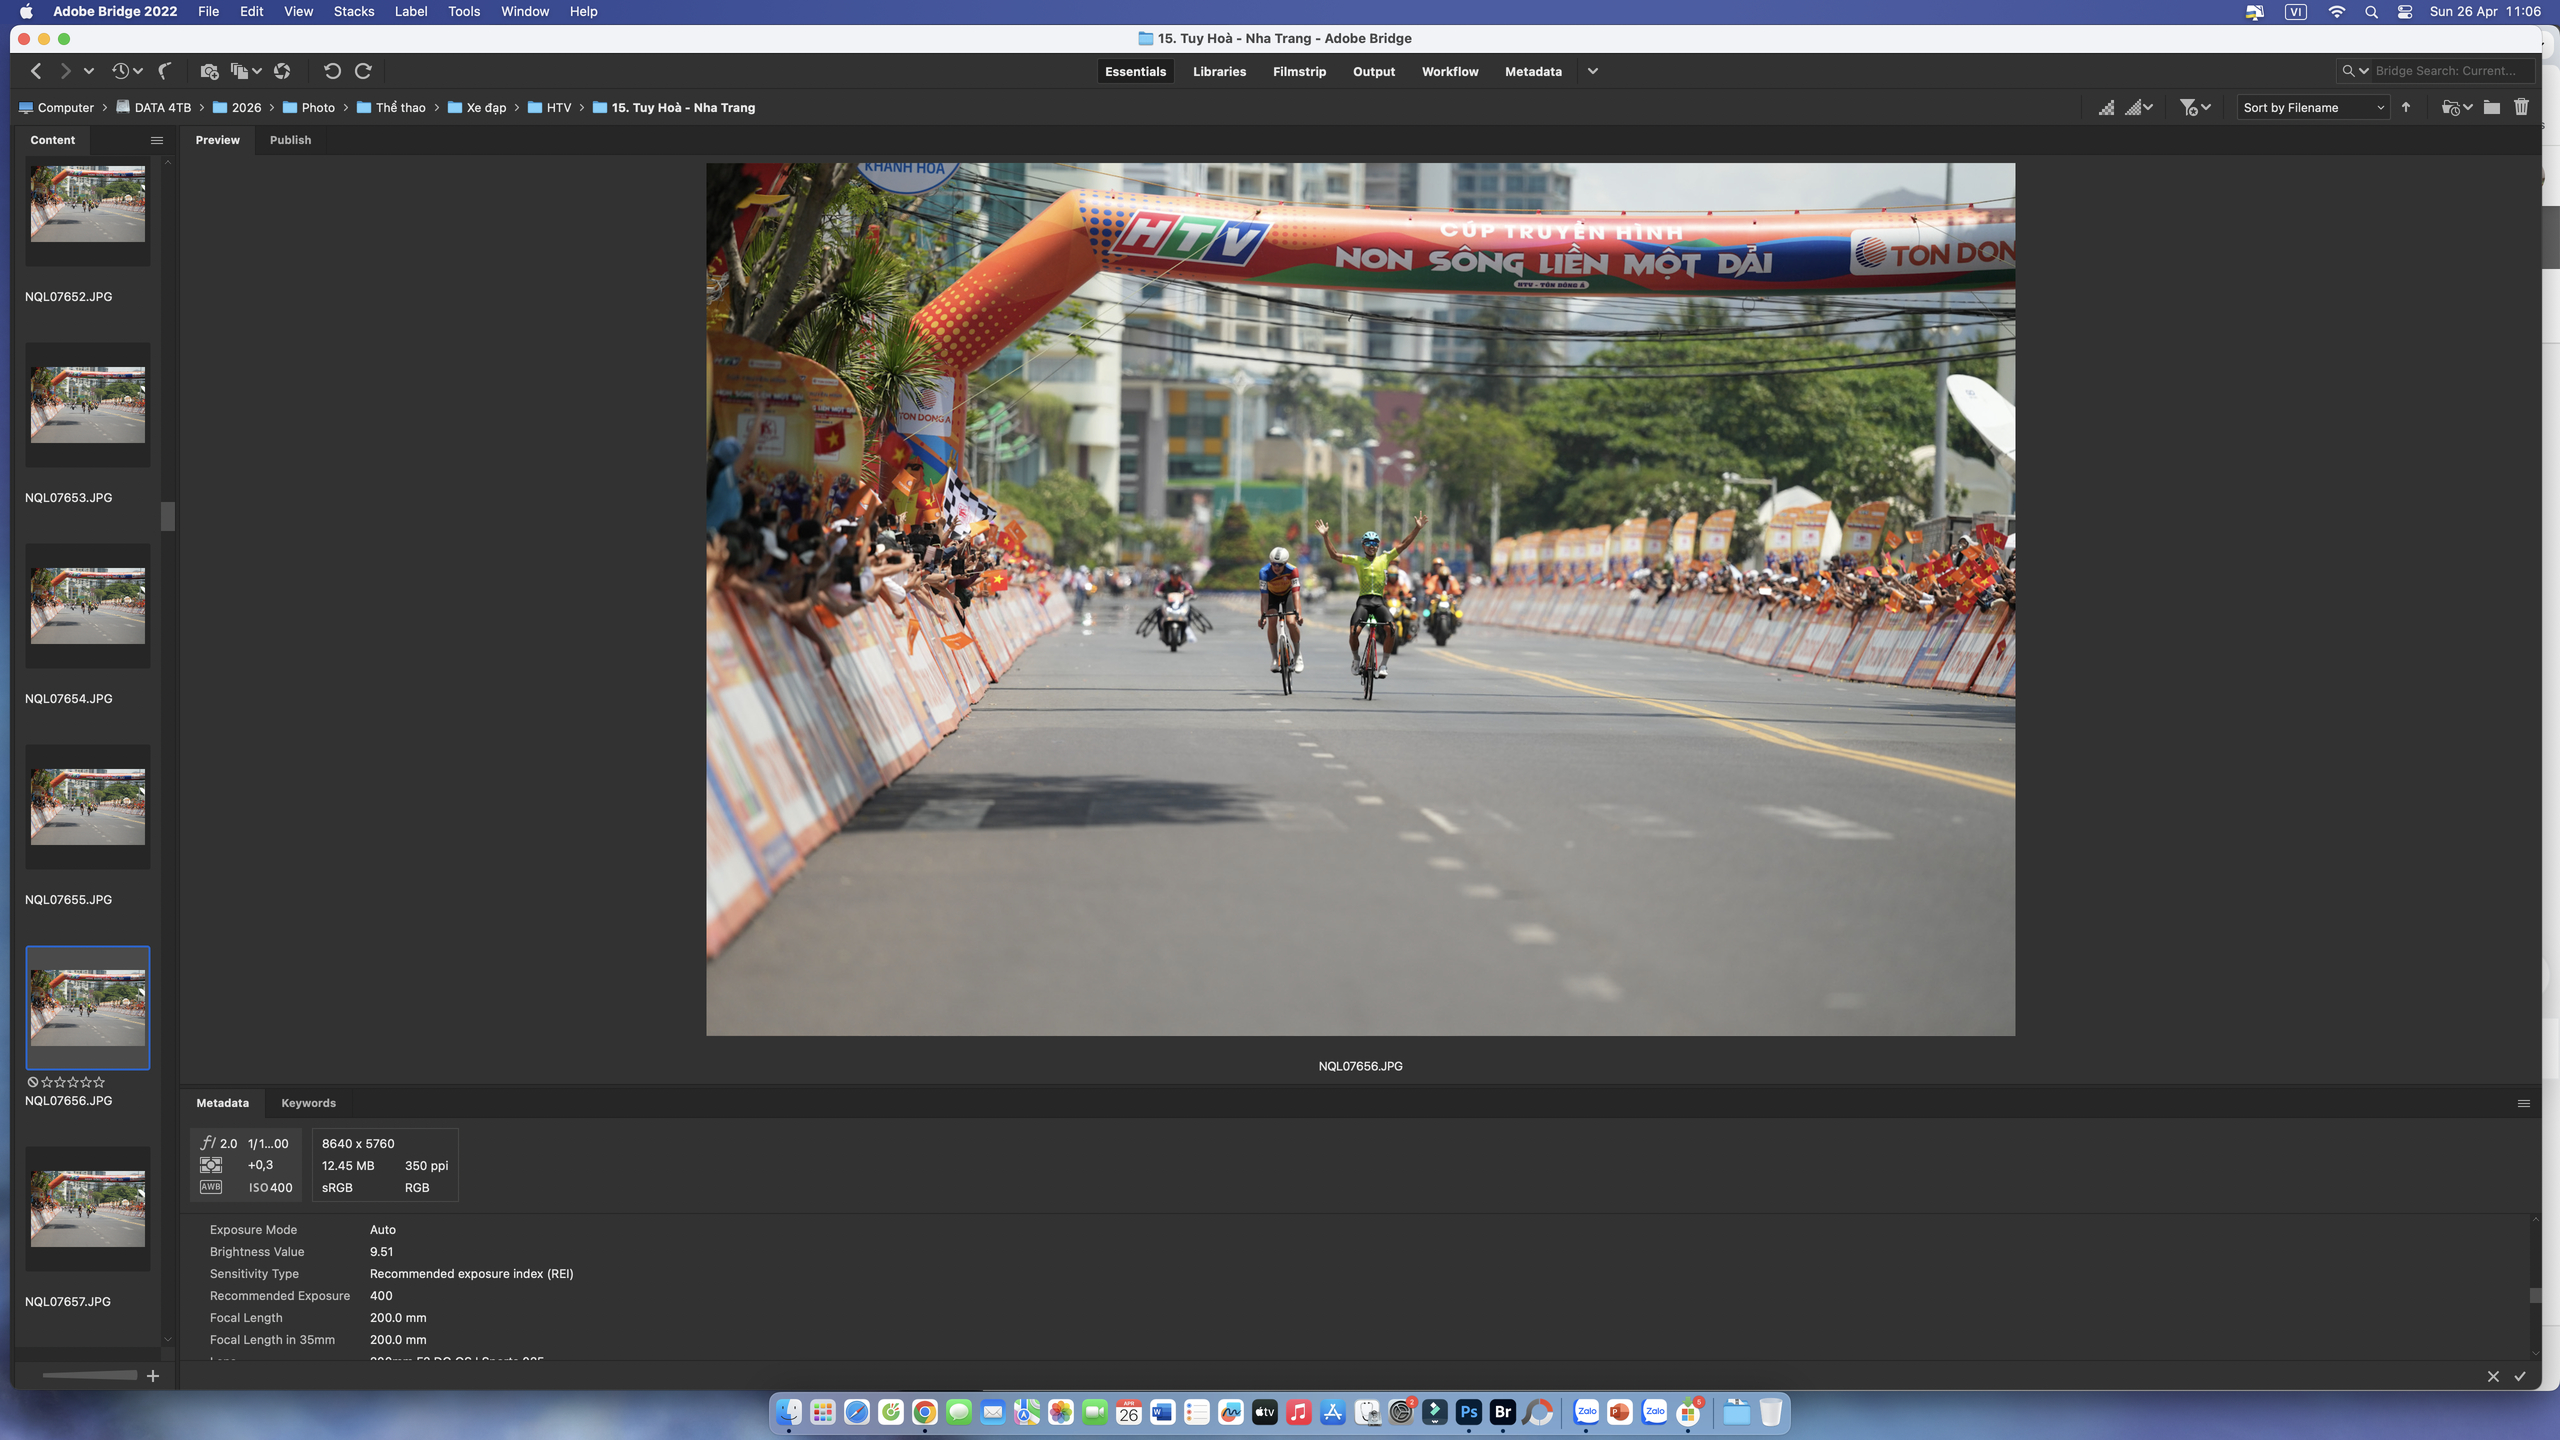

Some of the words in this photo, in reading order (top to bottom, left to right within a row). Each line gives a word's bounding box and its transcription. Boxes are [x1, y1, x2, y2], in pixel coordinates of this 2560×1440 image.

[53, 5, 96, 17] Adobe
[98, 4, 142, 20] Bridge
[144, 5, 178, 17] 2022
[198, 5, 220, 17] File
[240, 5, 264, 17] Edit
[284, 5, 314, 17] View
[334, 5, 375, 17] Stacks
[395, 5, 428, 17] Label
[448, 5, 481, 17] Tools
[501, 5, 550, 17] Window
[570, 5, 599, 19] Help
[2290, 7, 2302, 17] VI
[2430, 5, 2453, 17] Sun
[2457, 5, 2473, 17] 26
[2476, 5, 2499, 19] Apr
[2506, 5, 2542, 17] 11:06
[1158, 33, 1177, 44] 15.
[1180, 33, 1205, 47] Tuy
[1207, 32, 1233, 44] Hoà
[1245, 32, 1272, 44] Nha
[1274, 33, 1312, 47] Trang
[1324, 32, 1367, 44] Adobe
[1369, 32, 1413, 47] Bridge
[1105, 65, 1167, 77] Essentials
[1193, 65, 1247, 77] Libraries
[1273, 65, 1327, 79] Filmstrip
[1353, 66, 1396, 79] Output
[1421, 66, 1480, 77] Workflow
[1505, 66, 1563, 77] Metadata
[2376, 65, 2413, 78] Bridge
[2416, 65, 2459, 76] Search:
[2462, 65, 2516, 76] Current...
[37, 102, 95, 115] Computer
[135, 102, 166, 113] DATA
[168, 102, 192, 113] 4TB
[232, 102, 262, 113] 2026
[302, 102, 336, 113] Photo
[375, 99, 398, 113] Thể
[400, 102, 427, 113] thao
[466, 102, 482, 113] Xe
[484, 102, 507, 116] đạp
[547, 102, 572, 113] HTV
[611, 102, 630, 113] 15.
[632, 102, 655, 115] Tuy
[657, 101, 682, 113] Hoà
[693, 102, 718, 113] Nha
[720, 102, 756, 115] Trang
[2244, 102, 2268, 113] Sort
[2271, 102, 2285, 115] by
[2288, 102, 2339, 113] Filename
[30, 135, 76, 145] Content
[195, 134, 241, 145] Preview
[270, 134, 312, 145] Publish
[1440, 220, 1496, 239] CÚP
[1505, 219, 1606, 240] TRUYỀN
[1617, 222, 1684, 240] HÌNH
[1121, 216, 1263, 259] HTV
[1891, 243, 1950, 267] TON
[1335, 245, 1413, 271] NON
[1428, 243, 1524, 278] SÔNG
[1539, 242, 1608, 275] LIỀN
[1623, 246, 1702, 281] MỘT
[1717, 244, 1773, 279] DẢI
[25, 291, 113, 303] NQL07652.JPG
[899, 412, 917, 421] TON
[918, 413, 944, 423] DONG
[945, 416, 952, 424] A
[25, 492, 113, 504] NQL07653.JPG
[25, 693, 113, 705] NQL07654.JPG
[25, 894, 113, 906] NQL07655.JPG
[1318, 1060, 1404, 1073] NQL07656.JPG
[25, 1095, 113, 1107] NQL07656.JPG
[196, 1097, 250, 1108] Metadata
[281, 1097, 337, 1110] Keywords
[220, 1138, 238, 1149] 2.0
[321, 1138, 353, 1149] 8640
[355, 1140, 363, 1149] x
[365, 1138, 395, 1149] 5760
[247, 1159, 274, 1172] +0,3
[321, 1160, 353, 1171] 12.45
[356, 1160, 375, 1171] MB
[405, 1160, 428, 1171] 350
[430, 1160, 449, 1173] ppi
[201, 1182, 221, 1191] AWB
[321, 1182, 354, 1193] sRGB
[405, 1182, 430, 1193] RGB
[210, 1224, 263, 1237] Exposure
[265, 1224, 298, 1235] Mode
[369, 1224, 397, 1235] Auto
[210, 1246, 271, 1259] Brightness
[273, 1246, 305, 1257] Value
[369, 1246, 393, 1257] 9.51
[210, 1268, 269, 1281] Sensitivity
[271, 1268, 300, 1281] Type
[370, 1268, 455, 1279] Recommended
[457, 1270, 511, 1281] exposure
[513, 1268, 544, 1279] index
[547, 1268, 574, 1281] (REI)
[210, 1290, 295, 1301] Recommended
[298, 1290, 351, 1303] Exposure
[369, 1290, 393, 1301] 400
[25, 1296, 112, 1308] NQL07657.JPG
[210, 1312, 241, 1323] Focal
[243, 1312, 283, 1325] Length
[370, 1312, 403, 1323] 200.0
[405, 1314, 427, 1323] mm
[210, 1334, 241, 1345] Focal
[243, 1334, 283, 1347] Length
[286, 1334, 296, 1345] in
[299, 1334, 336, 1345] 35mm
[370, 1334, 403, 1345] 200.0
[405, 1336, 427, 1345] mm
[1119, 1409, 1138, 1422] 26
[1153, 1408, 1162, 1416] W
[1461, 1405, 1478, 1418] Ps
[1495, 1405, 1512, 1418] Br
[1578, 1407, 1598, 1415] Zalo
[1646, 1407, 1666, 1415] Zalo
